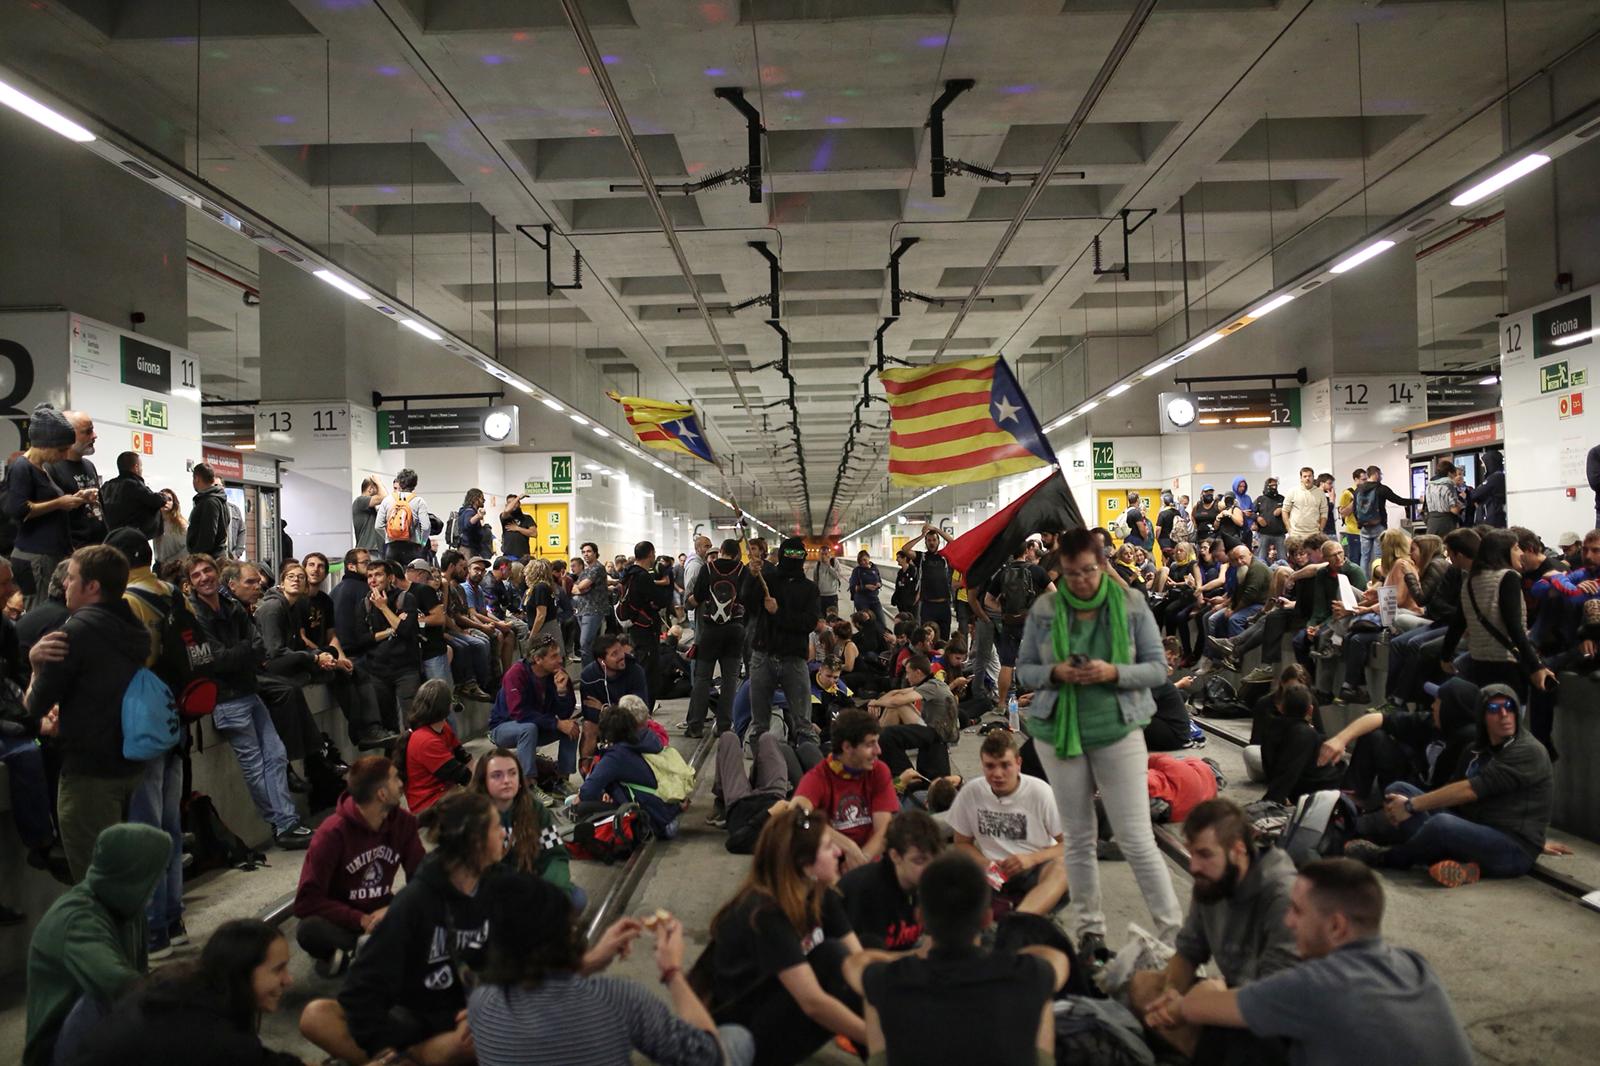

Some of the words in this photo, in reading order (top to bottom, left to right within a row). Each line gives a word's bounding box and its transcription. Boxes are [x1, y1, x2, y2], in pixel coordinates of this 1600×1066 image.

[1551, 318, 1578, 336] Girona
[1506, 323, 1521, 354] 12
[137, 357, 160, 375] Girona
[181, 359, 196, 388] 11
[1345, 384, 1368, 404] 12
[1388, 383, 1413, 403] 14
[269, 411, 292, 432] 13
[313, 410, 337, 431] 11
[1271, 408, 1291, 424] 12
[389, 430, 409, 445] 11
[1093, 446, 1113, 464] 7.12
[553, 461, 571, 478] 7.11
